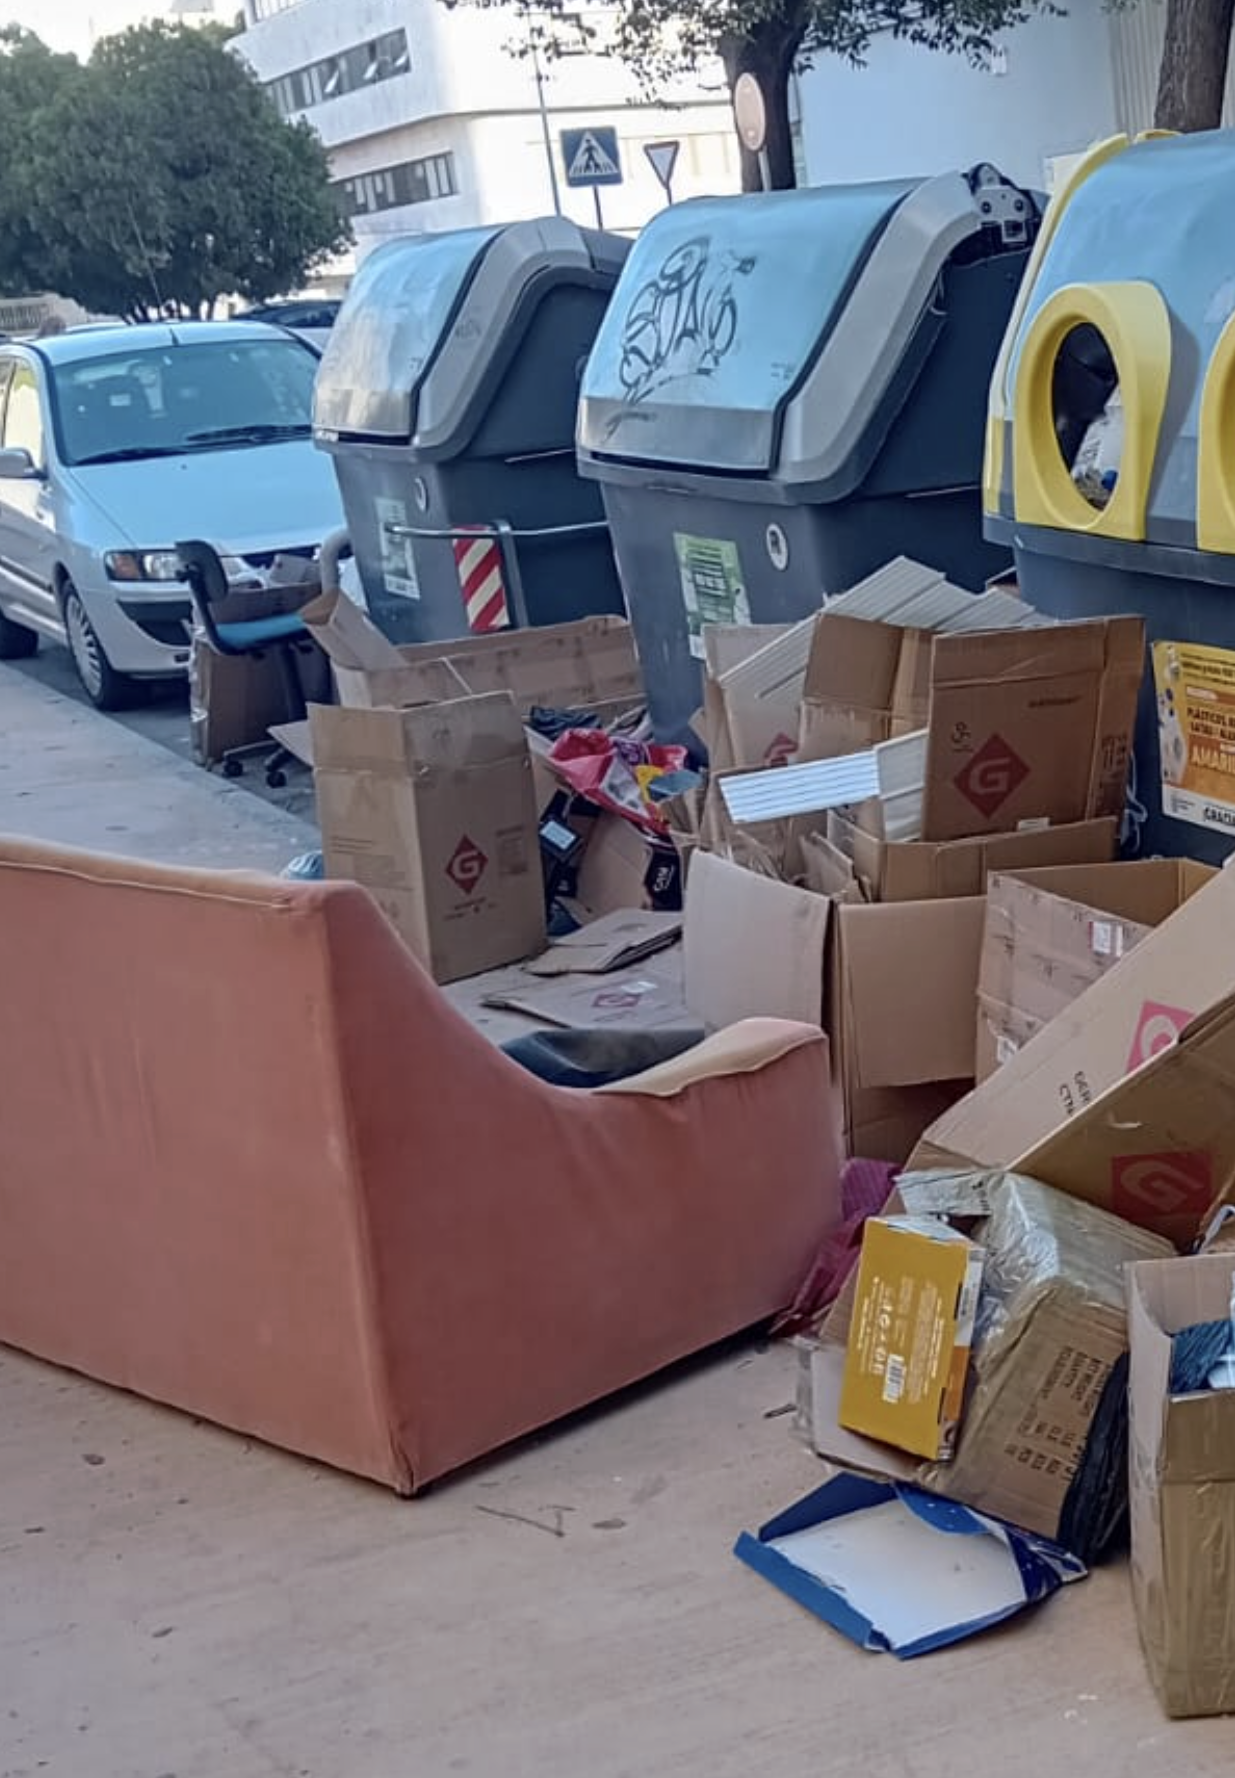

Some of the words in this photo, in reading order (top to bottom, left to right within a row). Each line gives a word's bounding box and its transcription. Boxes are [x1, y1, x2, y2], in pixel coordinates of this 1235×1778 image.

[968, 757, 1010, 796] G
[452, 850, 481, 881] G
[1120, 1160, 1204, 1212] G
